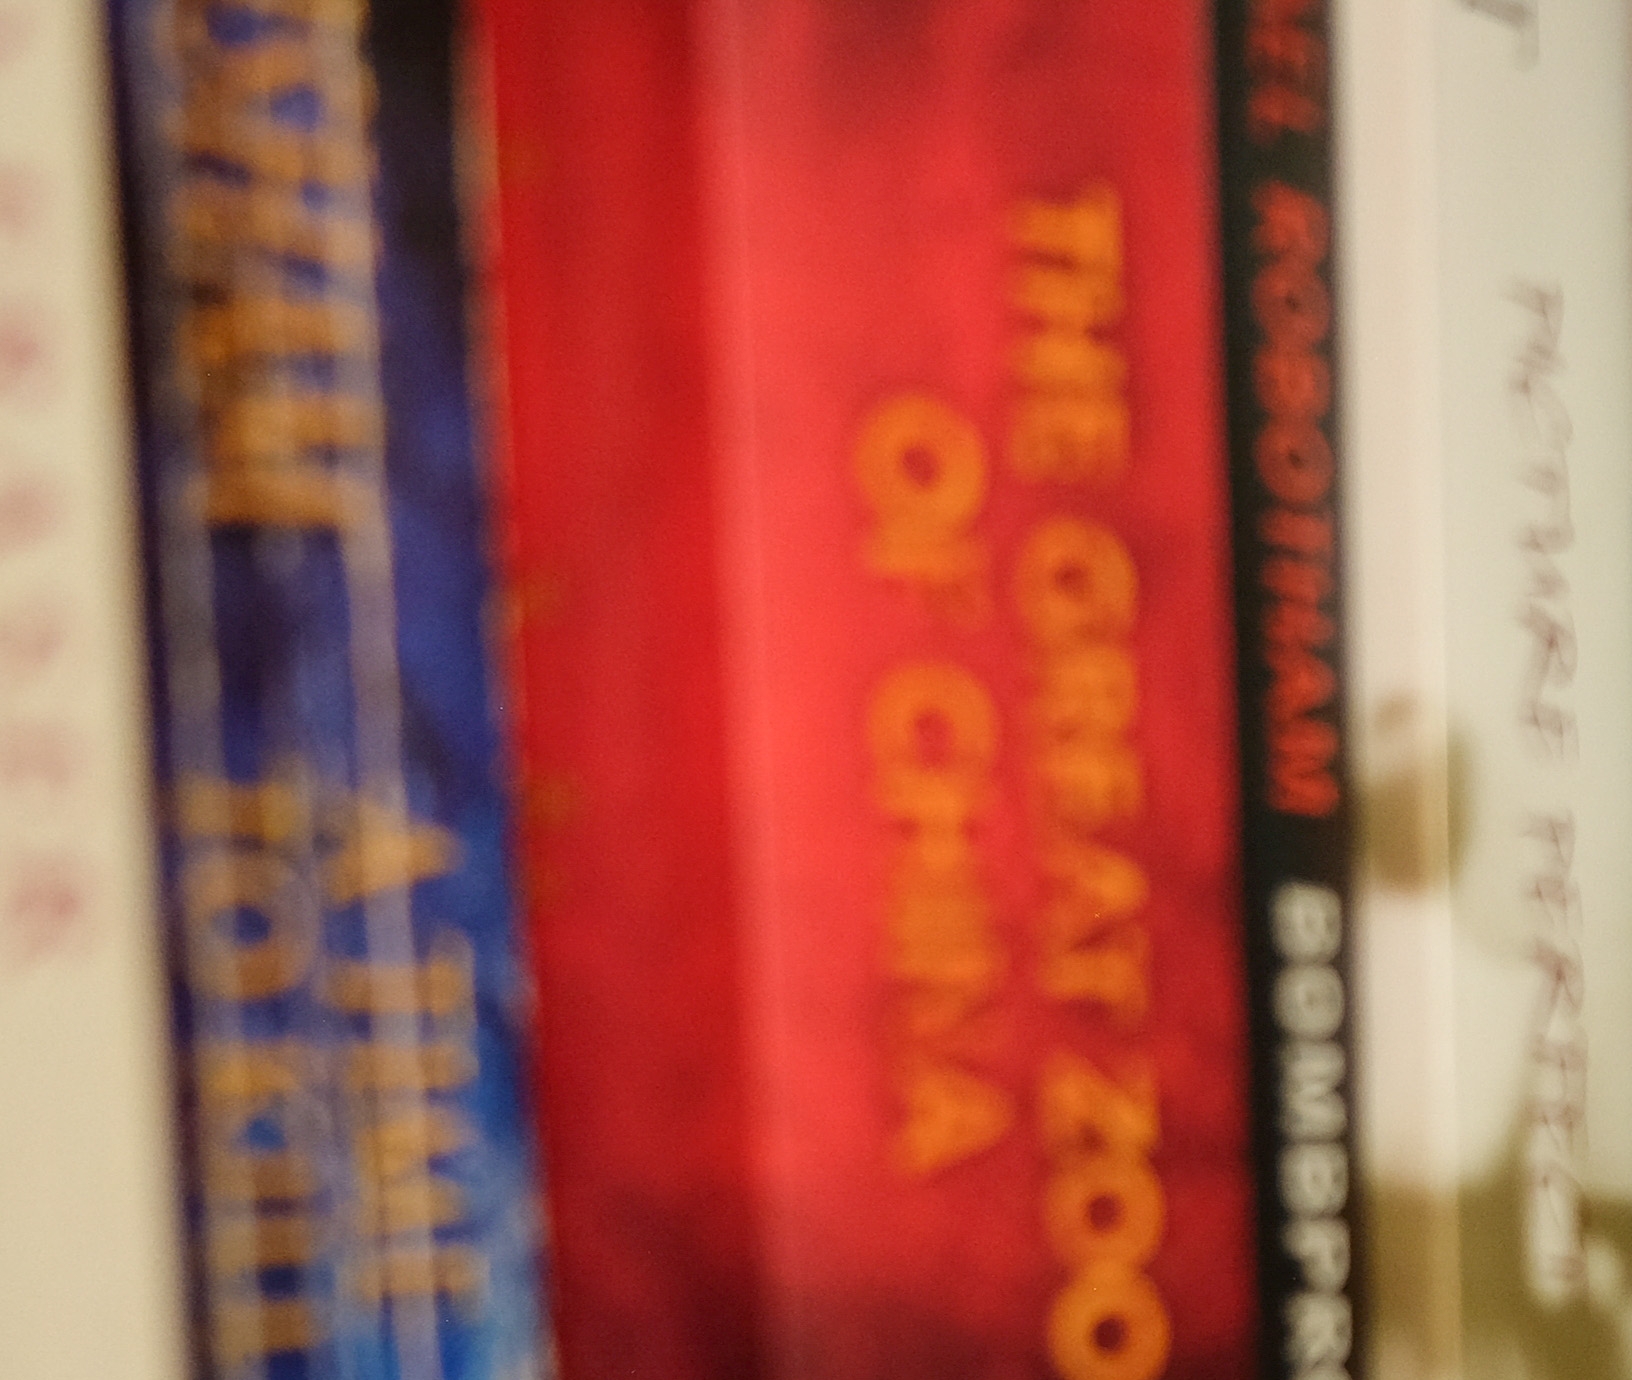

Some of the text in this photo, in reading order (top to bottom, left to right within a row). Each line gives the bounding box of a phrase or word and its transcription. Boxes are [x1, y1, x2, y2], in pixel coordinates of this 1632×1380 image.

[1008, 182, 1128, 482] THE
[1252, 180, 1341, 820] ROBOTHAM
[854, 393, 1010, 1175] OF CHINA
[1014, 516, 1148, 1022] GREAT
